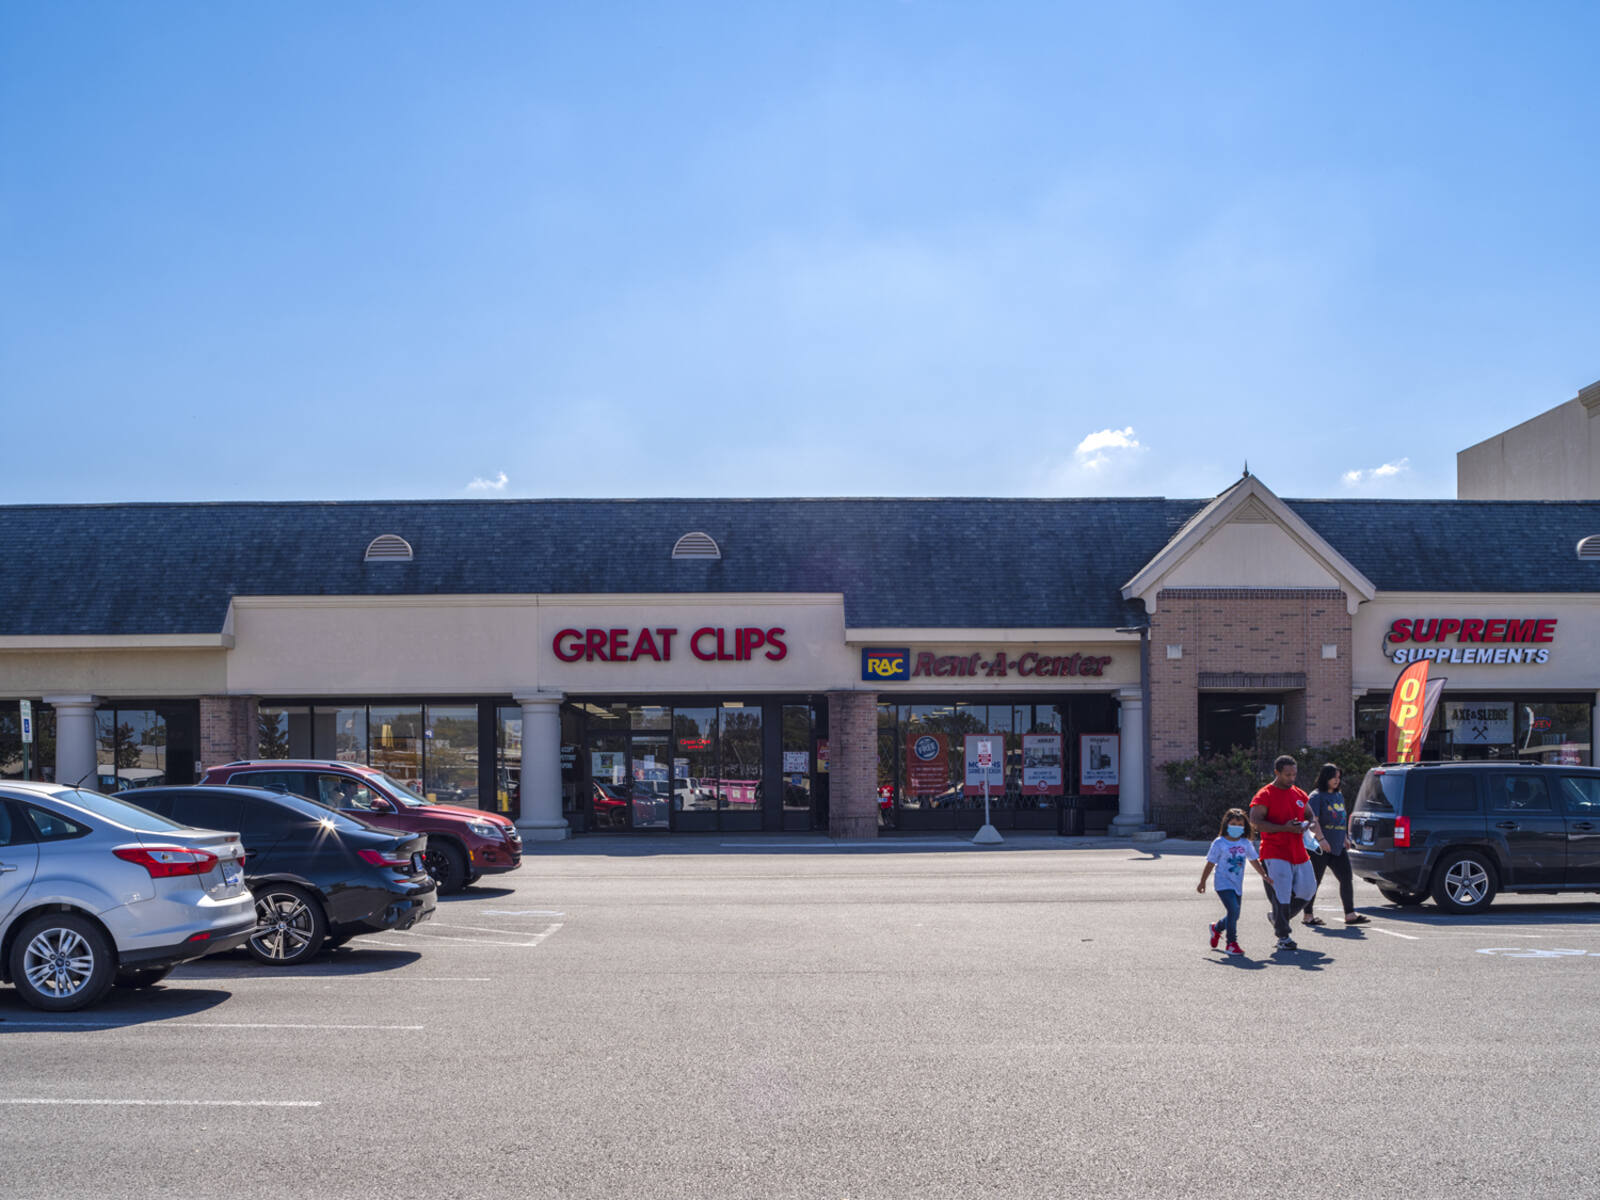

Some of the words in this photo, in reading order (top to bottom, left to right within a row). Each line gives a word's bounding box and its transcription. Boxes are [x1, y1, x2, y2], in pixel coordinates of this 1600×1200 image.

[1389, 618, 1558, 643] SUPREME
[552, 627, 678, 663] GREAT
[690, 626, 788, 662] CLIPS
[1392, 648, 1550, 664] SUPPLEMENTS
[867, 658, 904, 676] RAC
